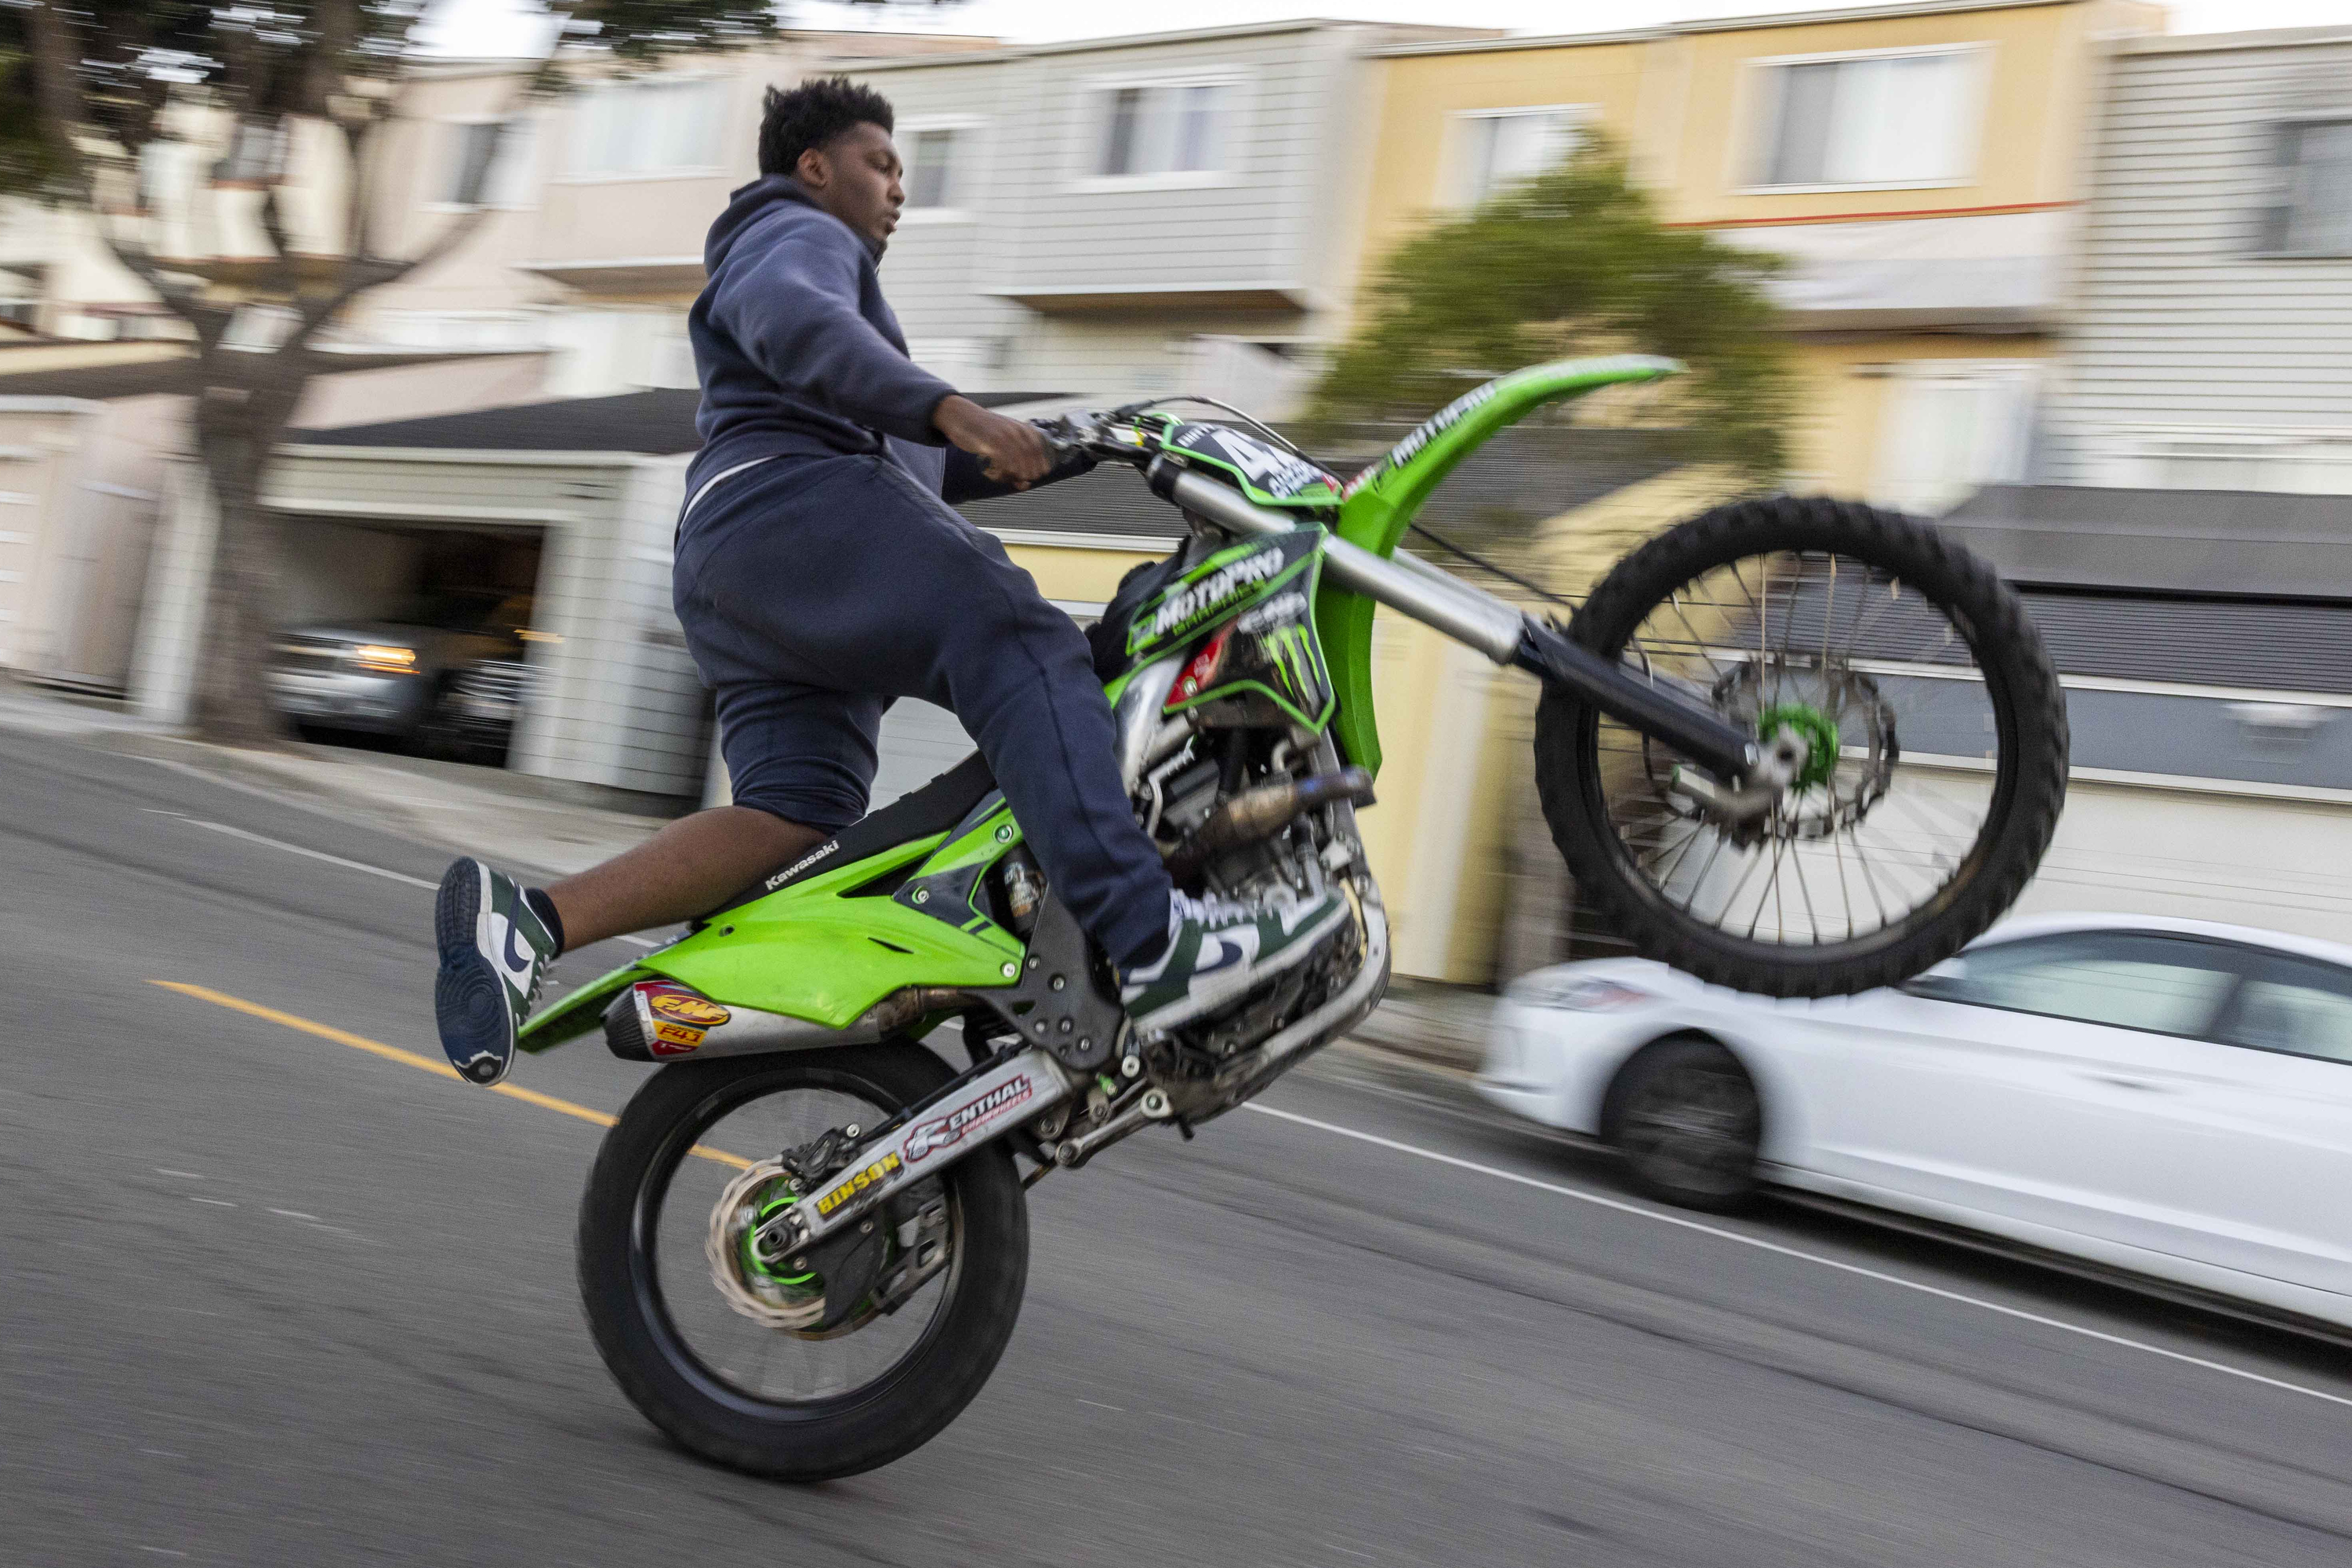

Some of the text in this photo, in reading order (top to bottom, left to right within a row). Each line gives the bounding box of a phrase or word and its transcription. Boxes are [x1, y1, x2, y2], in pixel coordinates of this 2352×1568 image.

[765, 840, 840, 891] Kawasaki
[651, 996, 730, 1020] FMF
[659, 1026, 702, 1043] F4.1
[905, 1076, 1030, 1161] RENTHAL
[816, 1152, 901, 1216] HINSON
